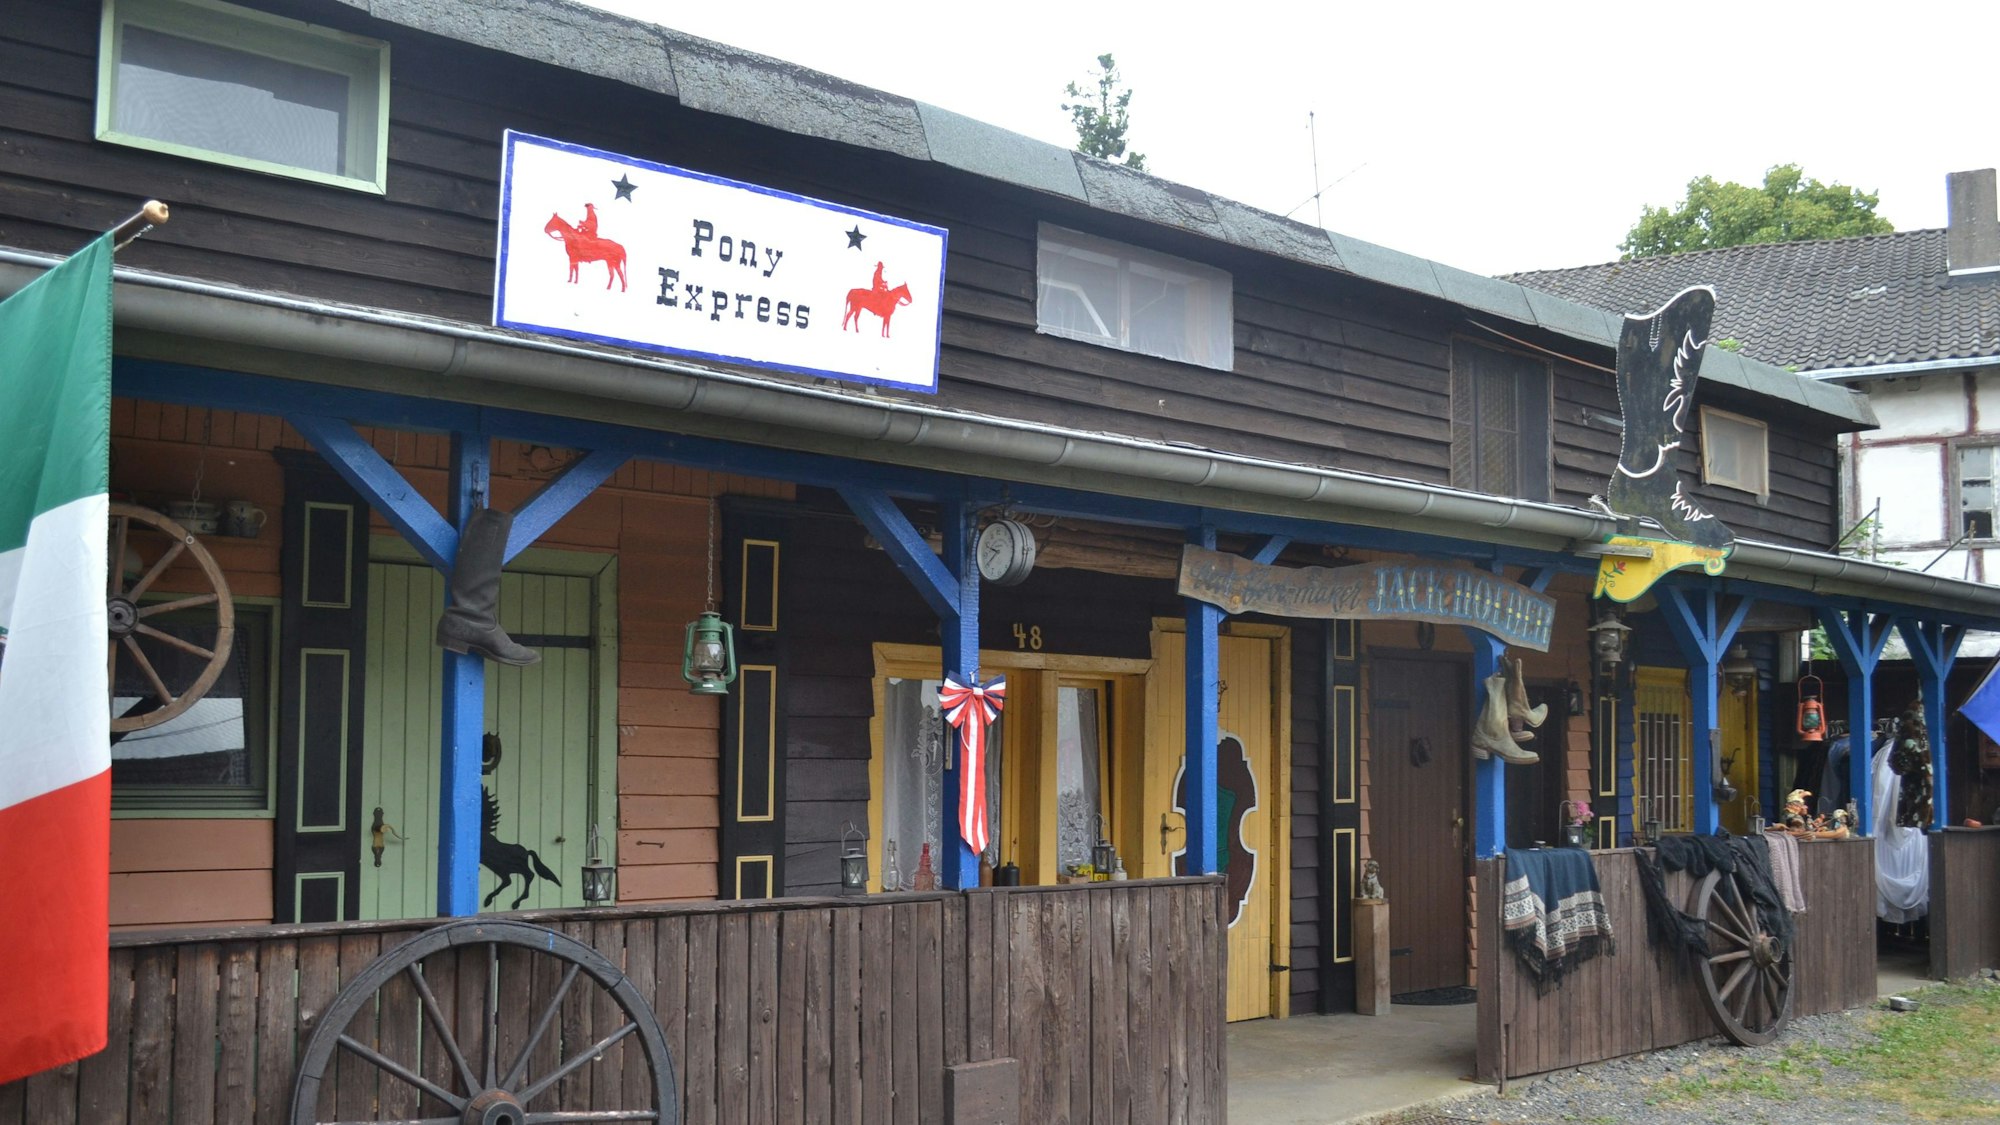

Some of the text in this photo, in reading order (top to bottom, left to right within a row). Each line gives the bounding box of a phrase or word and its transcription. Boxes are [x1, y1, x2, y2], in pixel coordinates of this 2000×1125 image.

[691, 218, 783, 277] Pony
[656, 267, 811, 329] Express
[1368, 566, 1448, 616] JACK
[1013, 622, 1043, 650] 48
